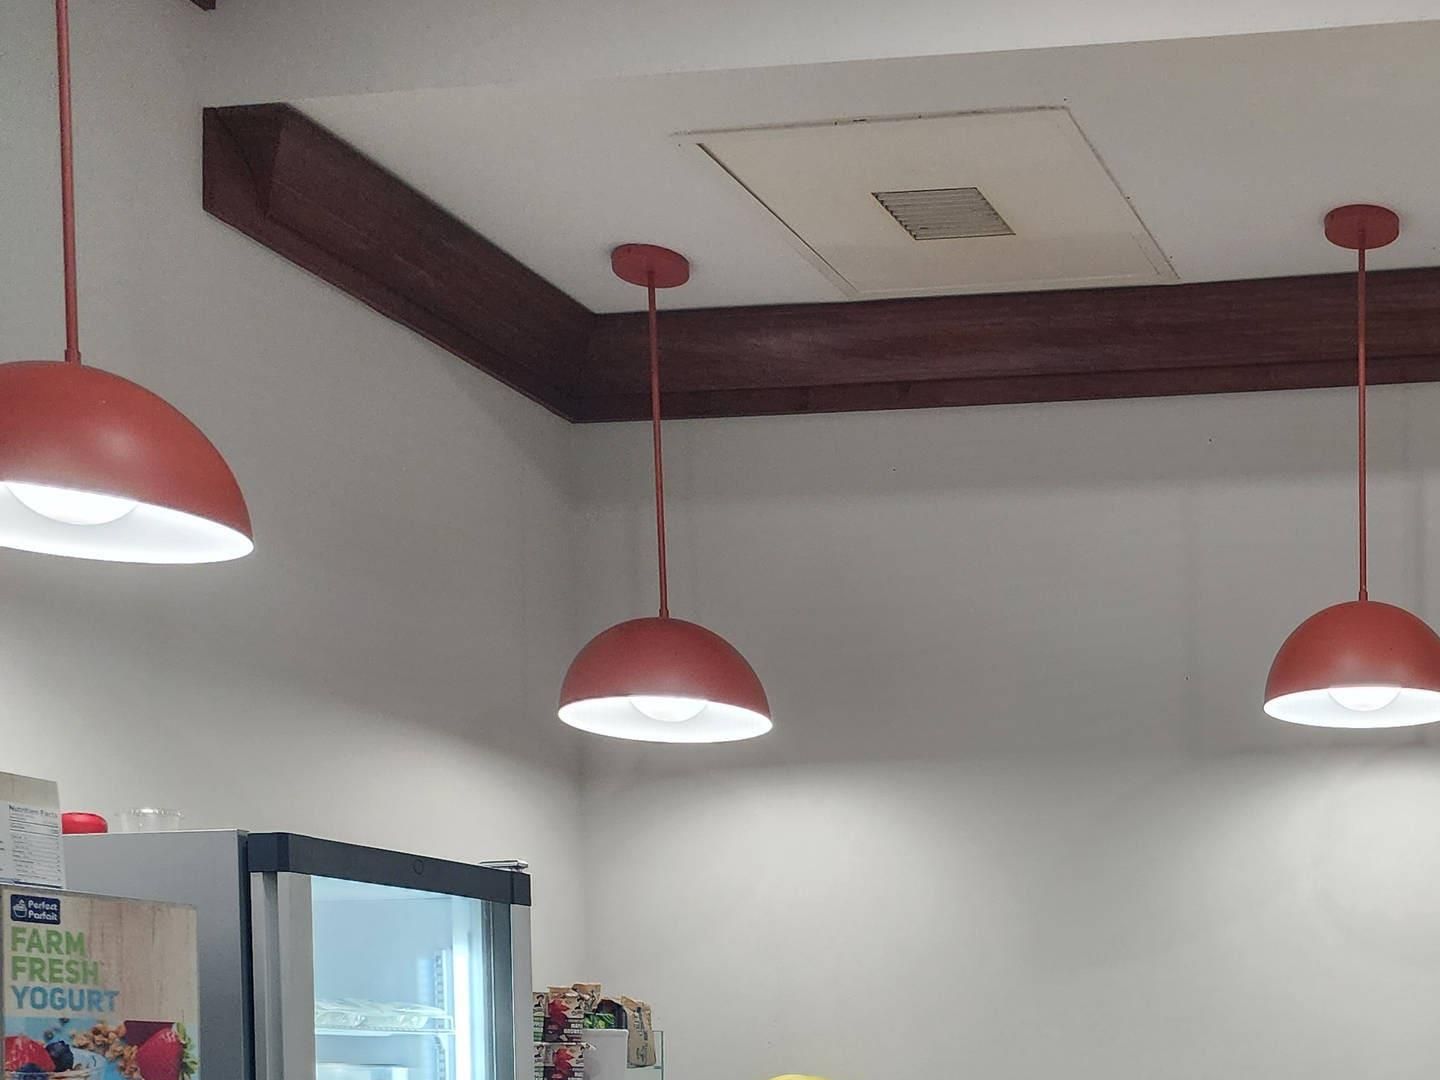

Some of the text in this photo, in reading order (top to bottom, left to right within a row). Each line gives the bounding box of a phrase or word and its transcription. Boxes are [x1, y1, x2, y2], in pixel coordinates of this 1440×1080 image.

[28, 900, 58, 911] Perfect
[28, 910, 58, 921] Parfait
[11, 926, 86, 956] FARM
[11, 956, 99, 986] FRESH
[11, 985, 120, 1012] YOGURT
